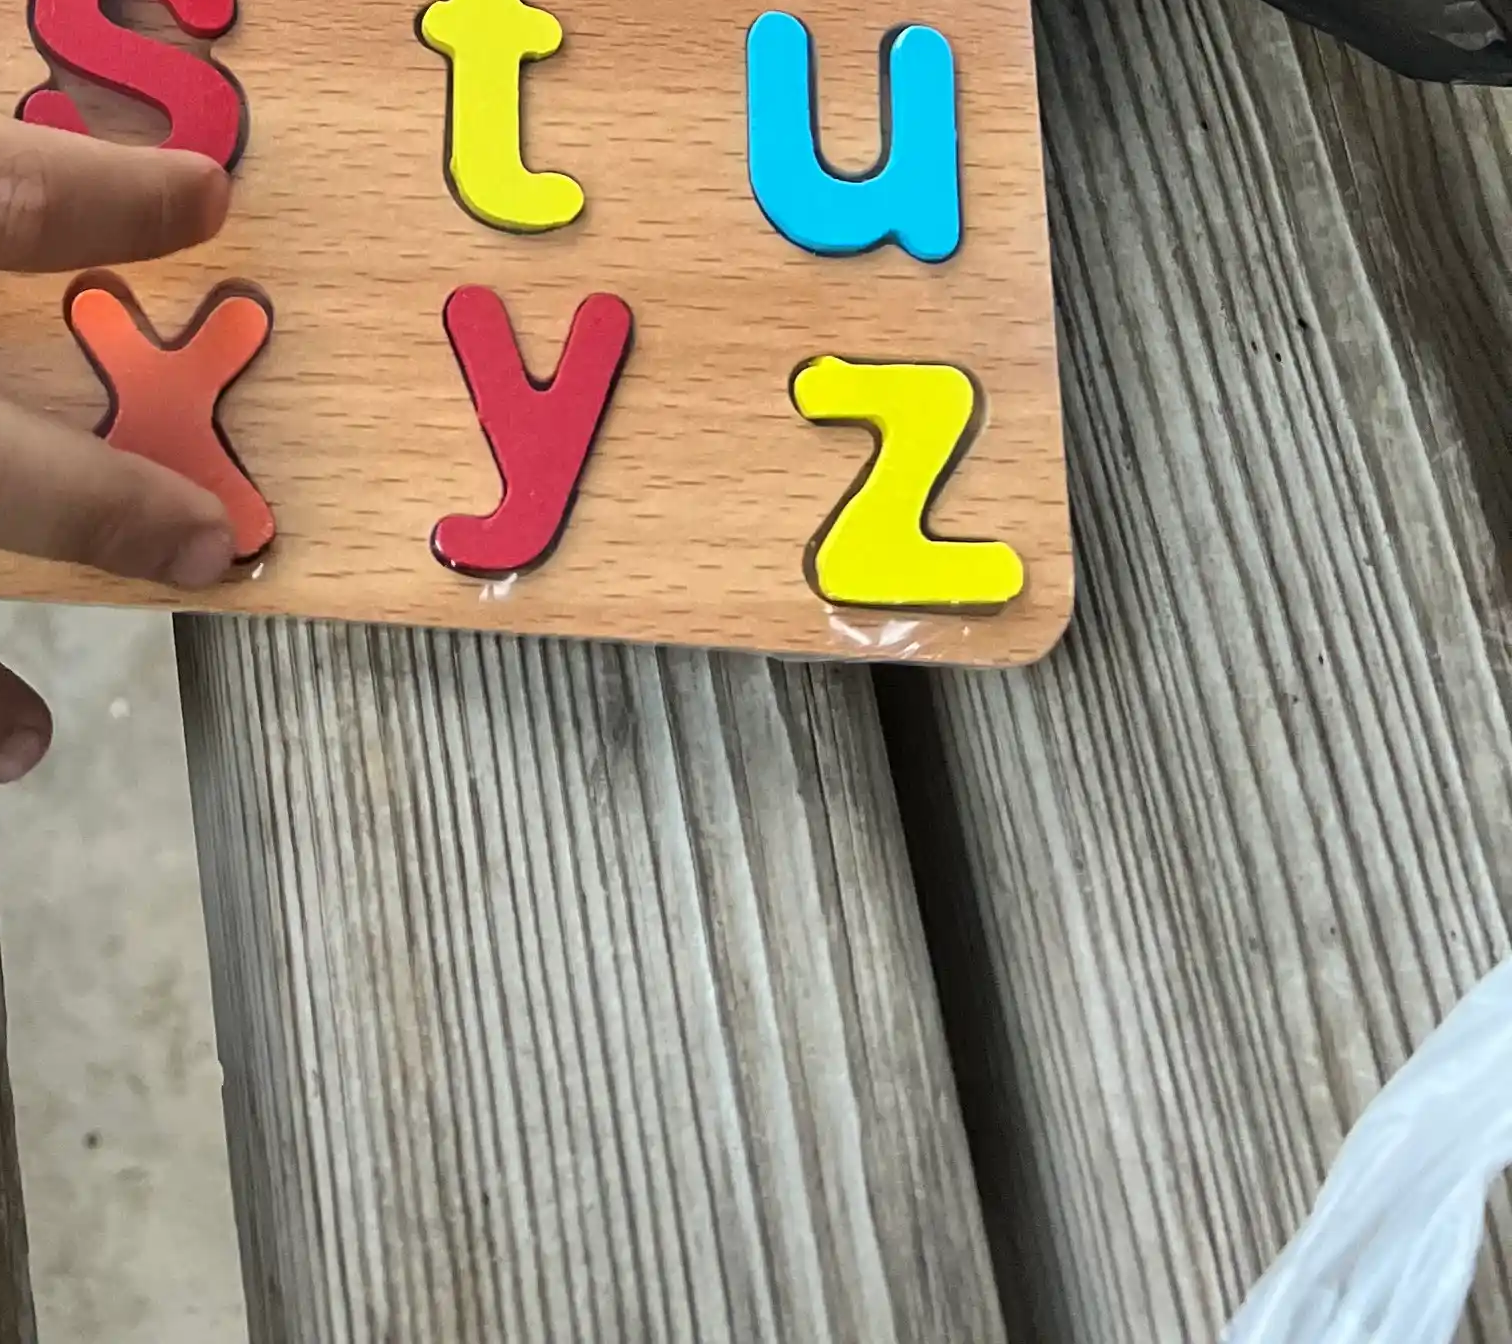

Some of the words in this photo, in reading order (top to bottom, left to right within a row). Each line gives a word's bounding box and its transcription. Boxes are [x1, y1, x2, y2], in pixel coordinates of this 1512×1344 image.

[745, 10, 958, 261] u
[66, 279, 278, 562] x
[430, 285, 634, 572] y
[790, 356, 1024, 604] z
